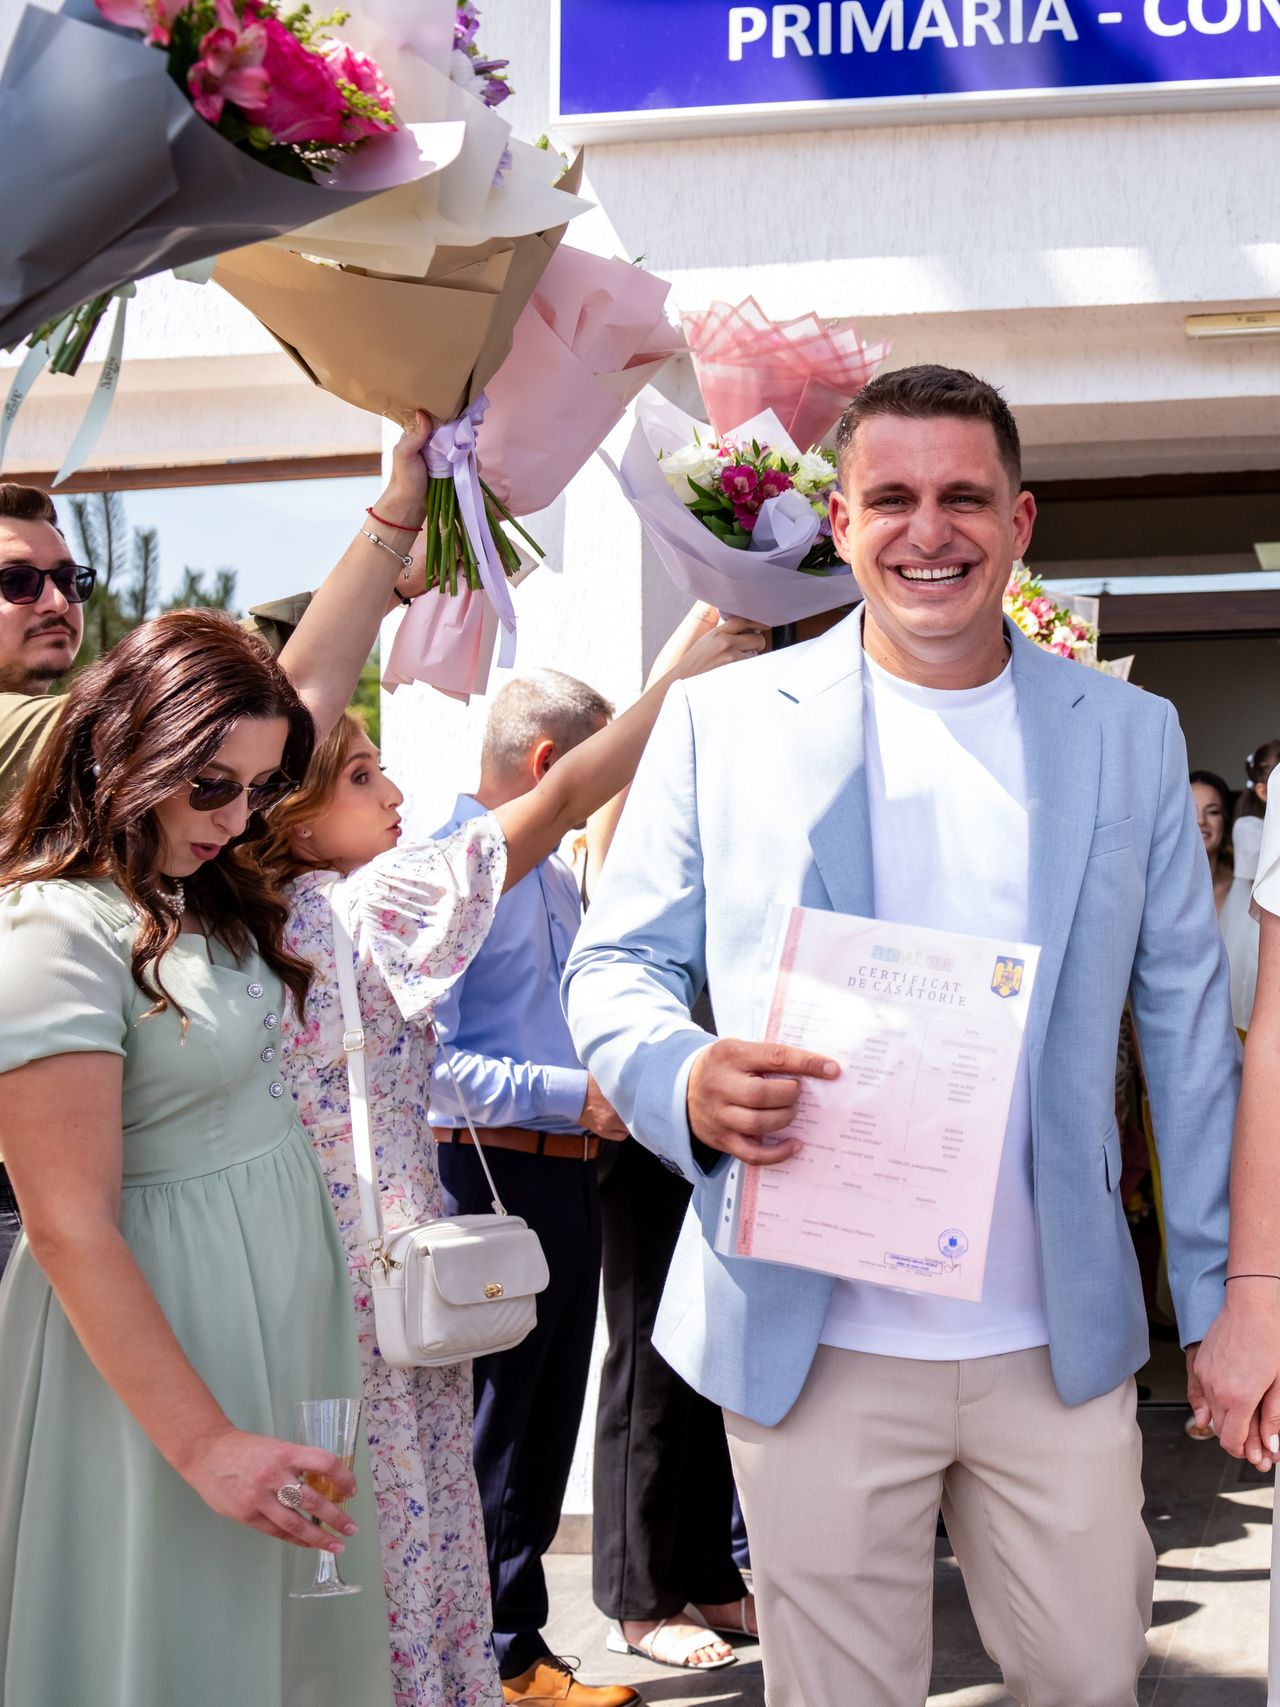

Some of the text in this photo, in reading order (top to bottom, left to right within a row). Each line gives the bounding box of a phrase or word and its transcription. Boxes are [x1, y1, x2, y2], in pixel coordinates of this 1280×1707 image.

[847, 976, 967, 1007] DE CĂSĂTORIE
[858, 965, 962, 993] CERTIFICAT
